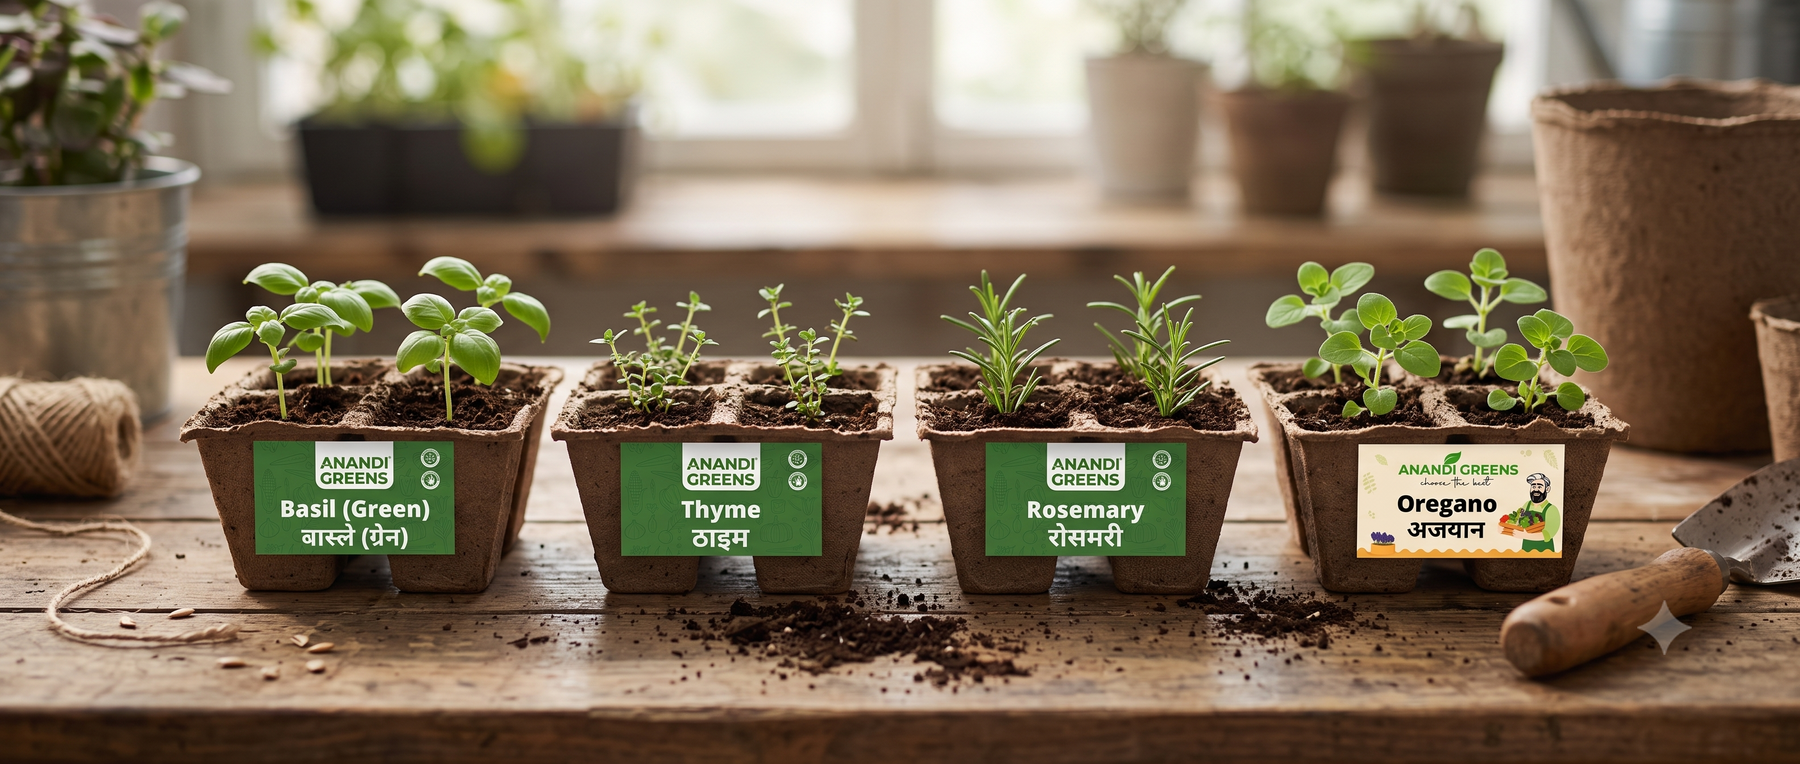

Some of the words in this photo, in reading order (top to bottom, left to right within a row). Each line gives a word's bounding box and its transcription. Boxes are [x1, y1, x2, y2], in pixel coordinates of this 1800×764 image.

[320, 472, 388, 485] GREENS
[687, 473, 755, 486] GREENS
[1052, 474, 1120, 486] GREENS
[1398, 464, 1456, 475] ANANDI
[1460, 464, 1519, 475] GREENS
[1451, 476, 1469, 488] the
[281, 499, 336, 518] Basil
[343, 499, 430, 521] (Green)
[682, 500, 761, 523] Thyme
[1027, 501, 1145, 523] Rosemary
[1397, 495, 1498, 518] Oregano
[301, 523, 356, 547] बास्ले
[361, 523, 409, 550] (ग्रेन)
[692, 530, 751, 552] ठाइम
[1048, 523, 1124, 547] रोसमरी
[1407, 521, 1486, 539] अजयान
